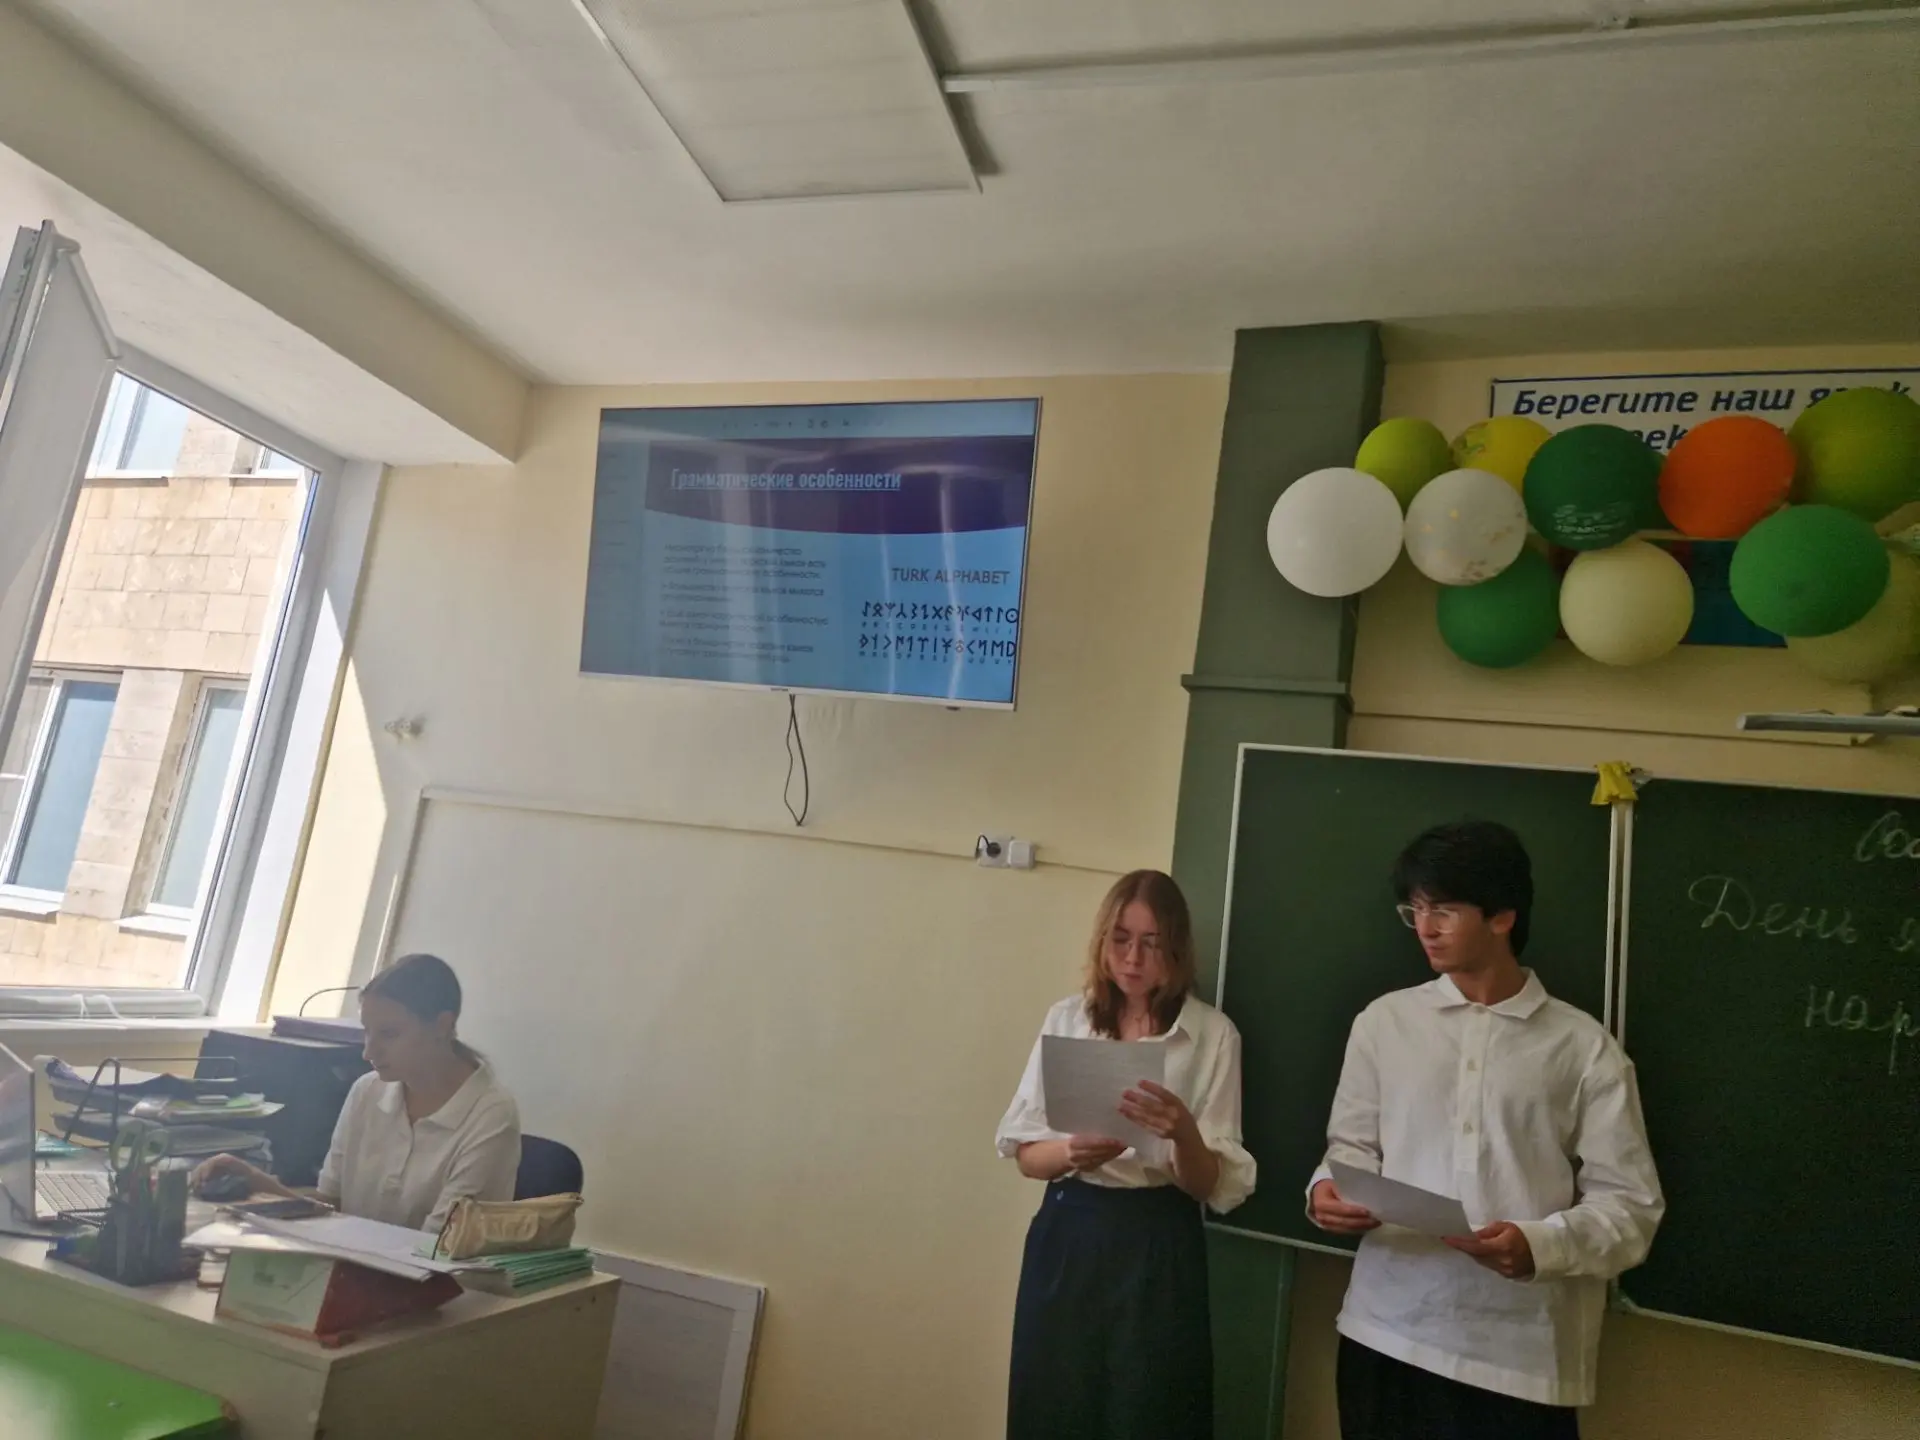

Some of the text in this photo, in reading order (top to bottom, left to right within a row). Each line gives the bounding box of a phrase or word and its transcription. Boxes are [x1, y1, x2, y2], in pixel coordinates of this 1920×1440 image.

[1512, 389, 1699, 420] Берегите
[1711, 387, 1795, 412] наш
[671, 467, 901, 490] Грамматические особенности
[891, 567, 1011, 586] TURK ALPHABET
[1687, 873, 1860, 946] День
